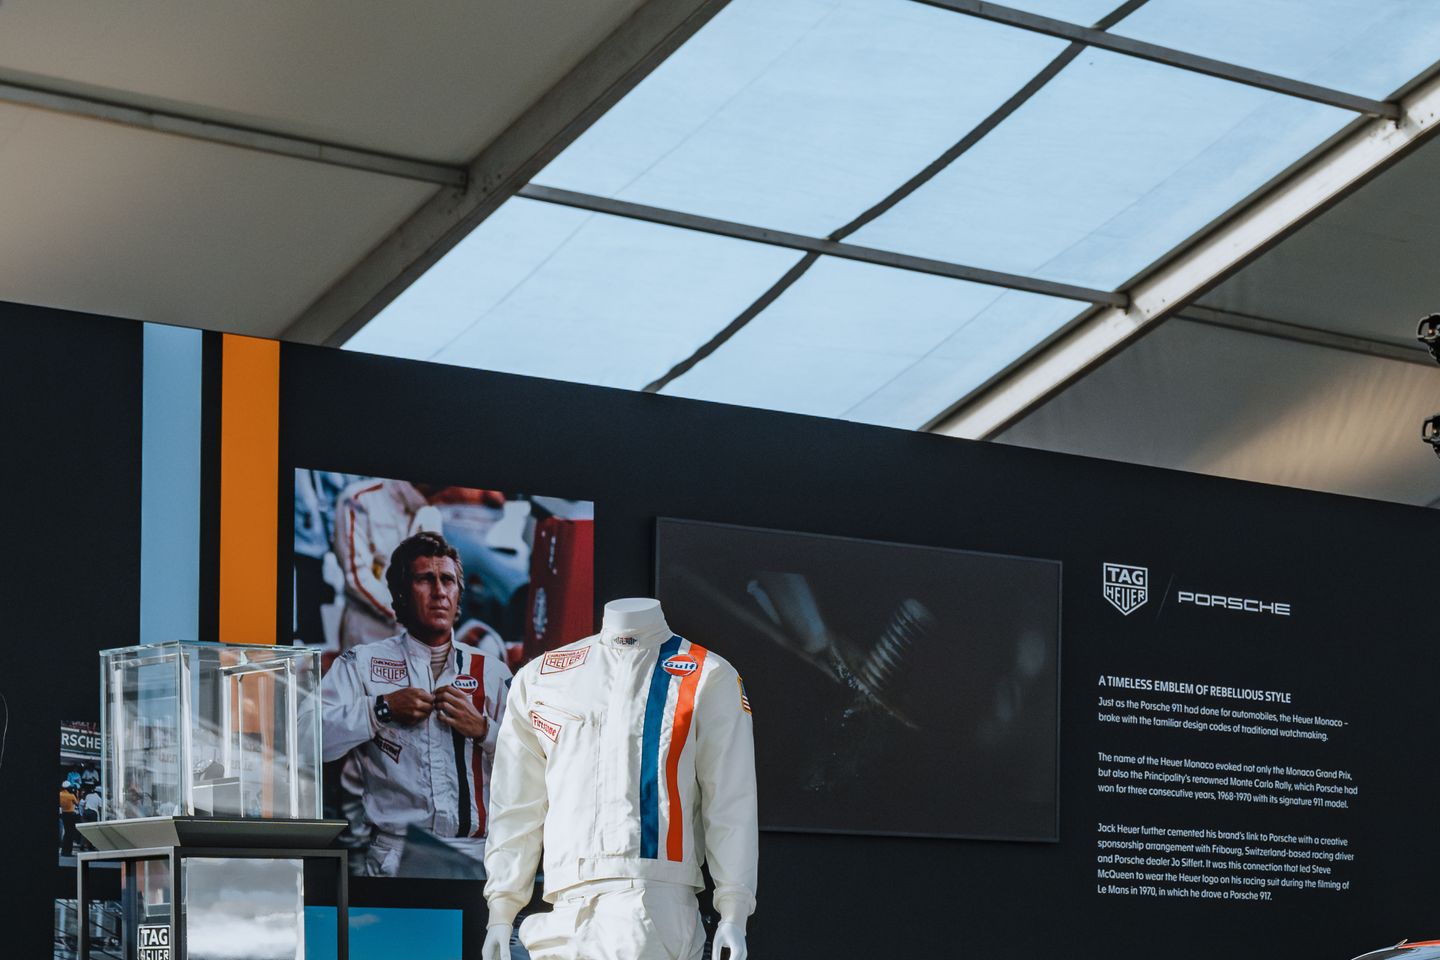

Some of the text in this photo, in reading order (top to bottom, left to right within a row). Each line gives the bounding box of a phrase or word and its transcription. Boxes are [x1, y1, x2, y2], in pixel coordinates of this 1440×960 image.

[1107, 567, 1144, 586] TAG
[1106, 586, 1145, 611] HEUER
[1178, 591, 1291, 616] PORSCHE
[376, 666, 406, 680] HEUER
[664, 661, 696, 670] Gulf
[1098, 675, 1291, 703] A TIMELESS EMBLEM OF REBELLIOUS STYLE
[1098, 696, 1114, 706] Just
[1126, 700, 1139, 709] the
[1140, 700, 1170, 712] Porsche
[1171, 703, 1182, 712] 911
[1184, 705, 1199, 714] had
[1200, 706, 1219, 716] done
[1220, 708, 1230, 717] for
[1231, 710, 1278, 722] automobiles,
[1279, 713, 1291, 722] the
[1292, 714, 1313, 724] Heuer
[1314, 716, 1343, 727] Monaco
[1098, 712, 1328, 742] broke with the familiar design codes of traditional watchmaking.
[1098, 752, 1112, 762] The
[1113, 755, 1136, 763] name
[1137, 755, 1145, 764] of
[1146, 756, 1159, 765] the
[1160, 757, 1182, 767] Heuer
[1184, 759, 1214, 769] Monaco
[1215, 762, 1242, 771] evoked
[1256, 765, 1272, 775] only
[1273, 766, 1284, 775] the
[1286, 766, 1314, 777] Monaco
[1315, 769, 1337, 778] Grand
[1338, 770, 1352, 780] Prix,
[141, 928, 168, 946] TAG
